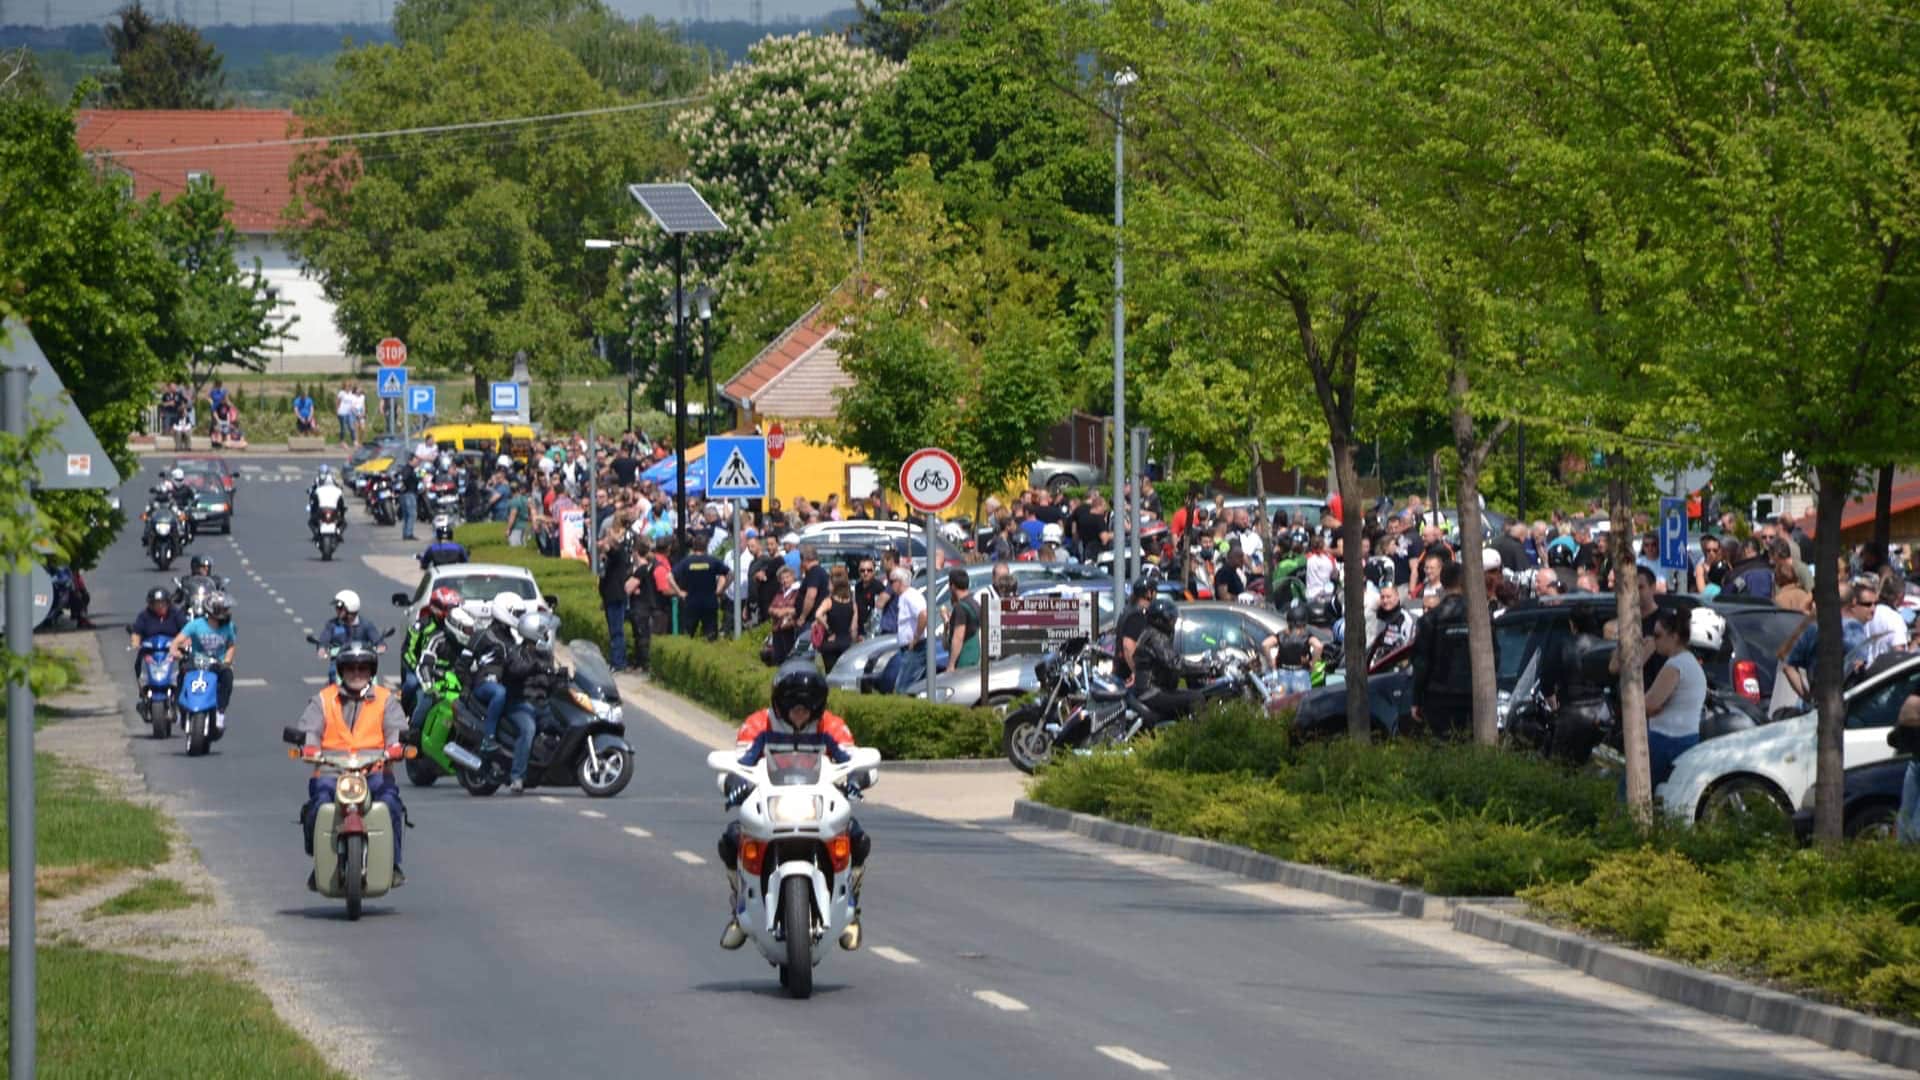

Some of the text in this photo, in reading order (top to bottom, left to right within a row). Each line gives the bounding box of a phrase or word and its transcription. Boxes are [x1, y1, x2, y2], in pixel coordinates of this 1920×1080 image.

[378, 346, 404, 359] STOP
[413, 389, 430, 411] P
[768, 434, 784, 448] STOP
[1666, 510, 1681, 560] P
